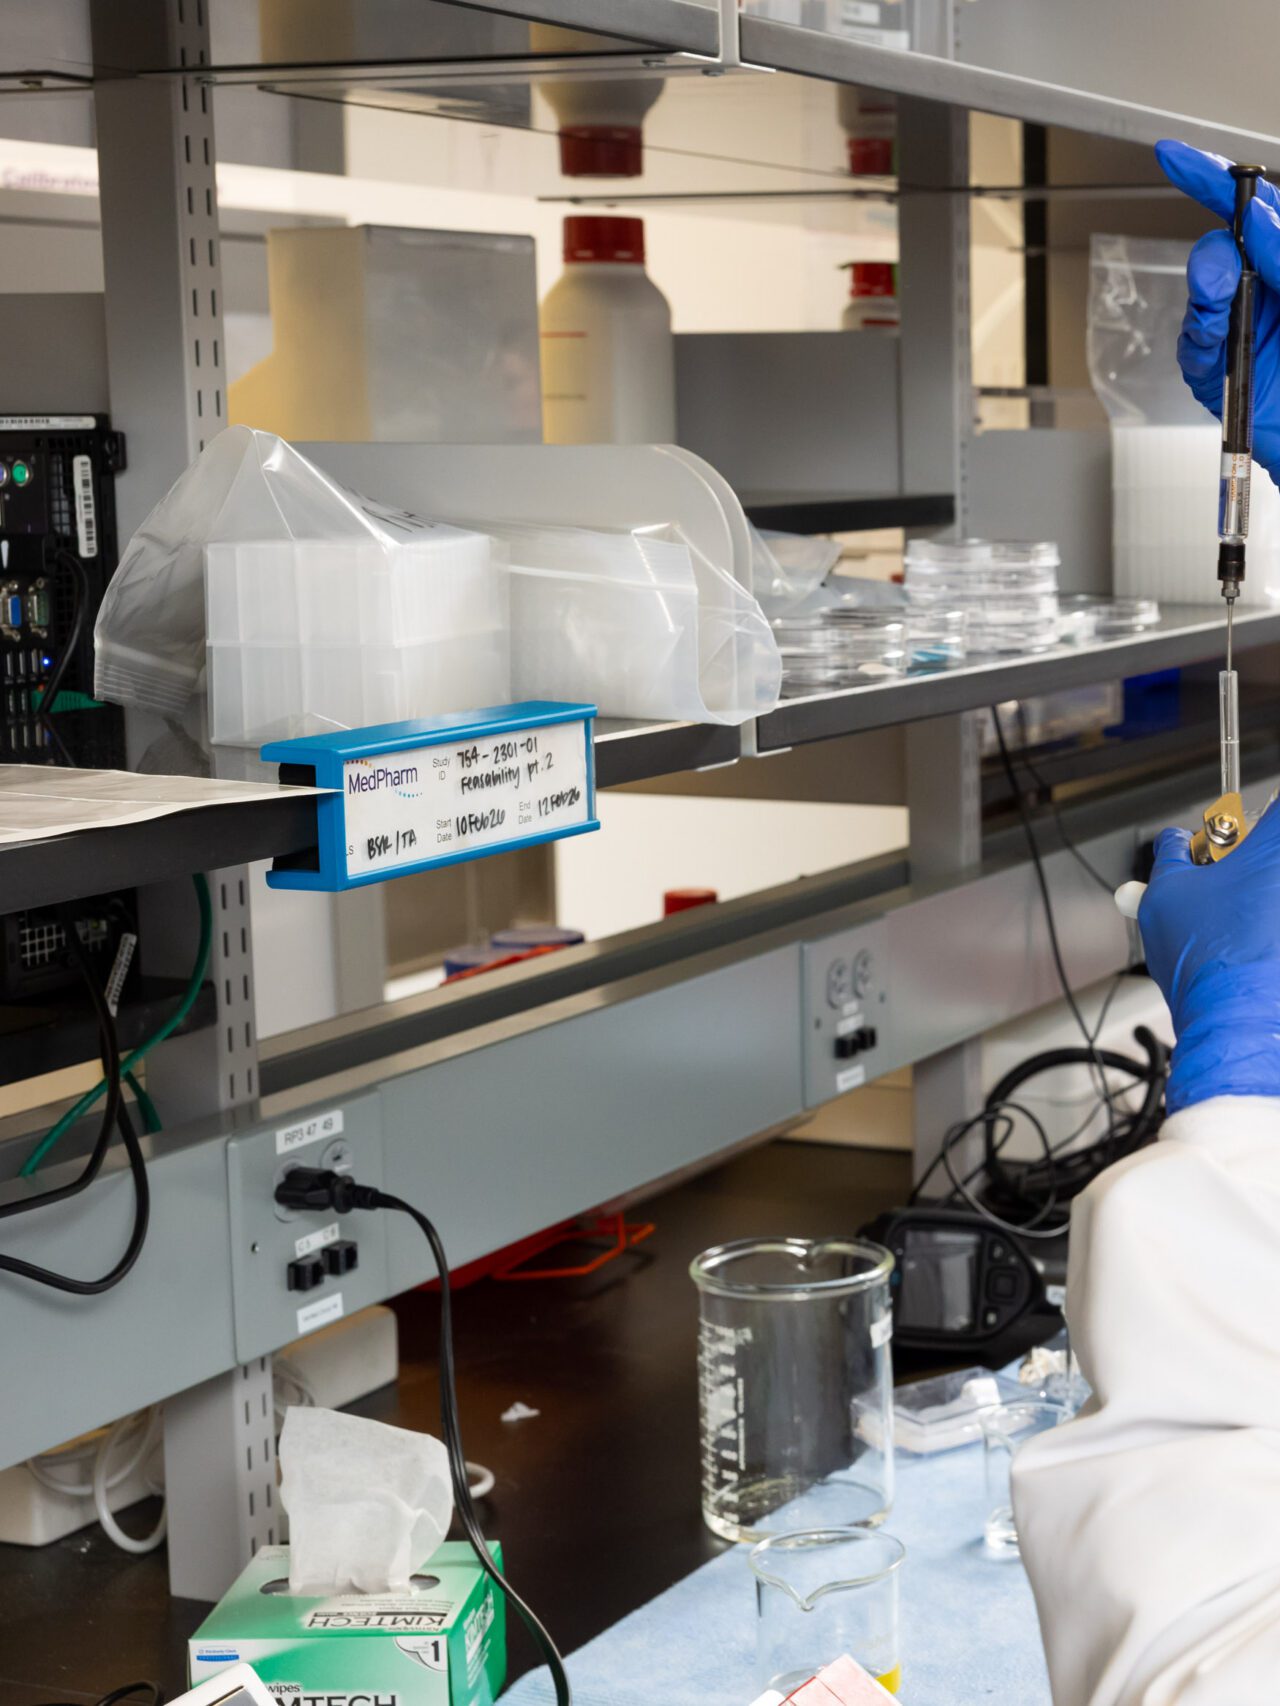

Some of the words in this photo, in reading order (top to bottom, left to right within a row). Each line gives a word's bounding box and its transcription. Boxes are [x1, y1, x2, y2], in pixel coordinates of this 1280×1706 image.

[432, 757, 451, 769] Study
[438, 770, 446, 780] ID
[348, 767, 418, 795] MedPharm
[519, 801, 531, 811] End
[436, 819, 451, 830] Start
[518, 814, 532, 825] Date
[436, 833, 453, 843] Date
[308, 1616, 445, 1627] KIMTECH
[431, 1640, 440, 1662] 1
[267, 1682, 300, 1694] wipes
